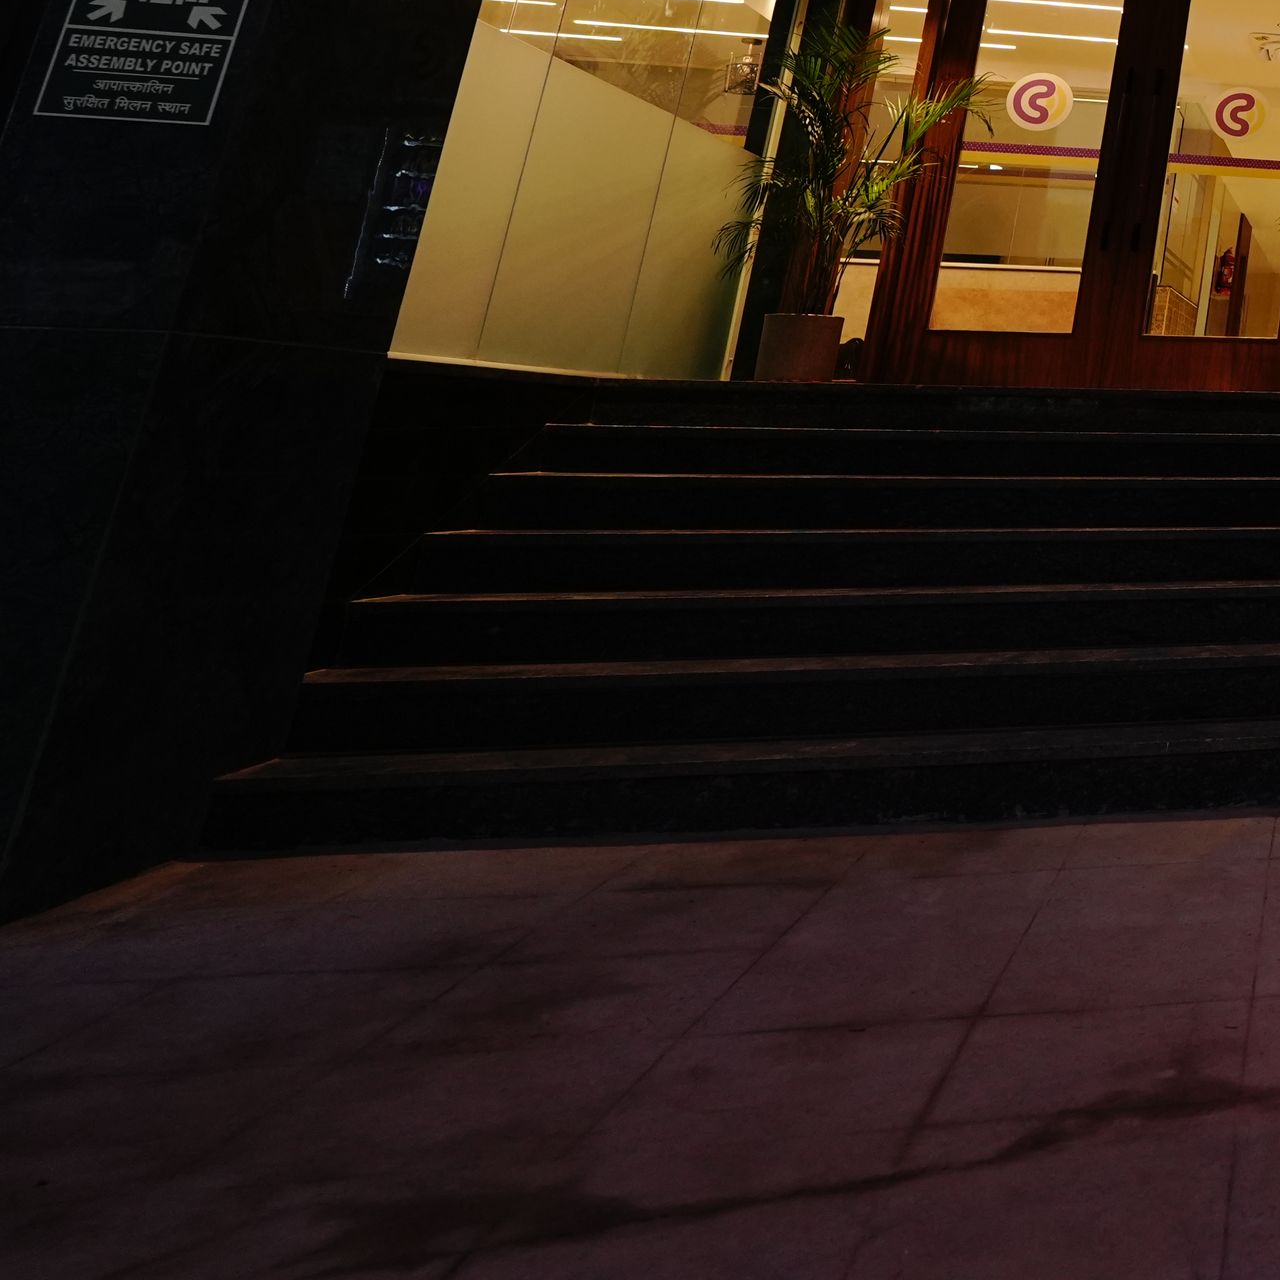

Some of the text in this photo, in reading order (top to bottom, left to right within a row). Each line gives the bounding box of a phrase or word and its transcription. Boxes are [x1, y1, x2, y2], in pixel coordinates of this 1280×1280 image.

[68, 34, 222, 58] EMERGENCY SAFE
[64, 53, 213, 76] ASSEMBLY POINT
[115, 96, 153, 112] मिलन
